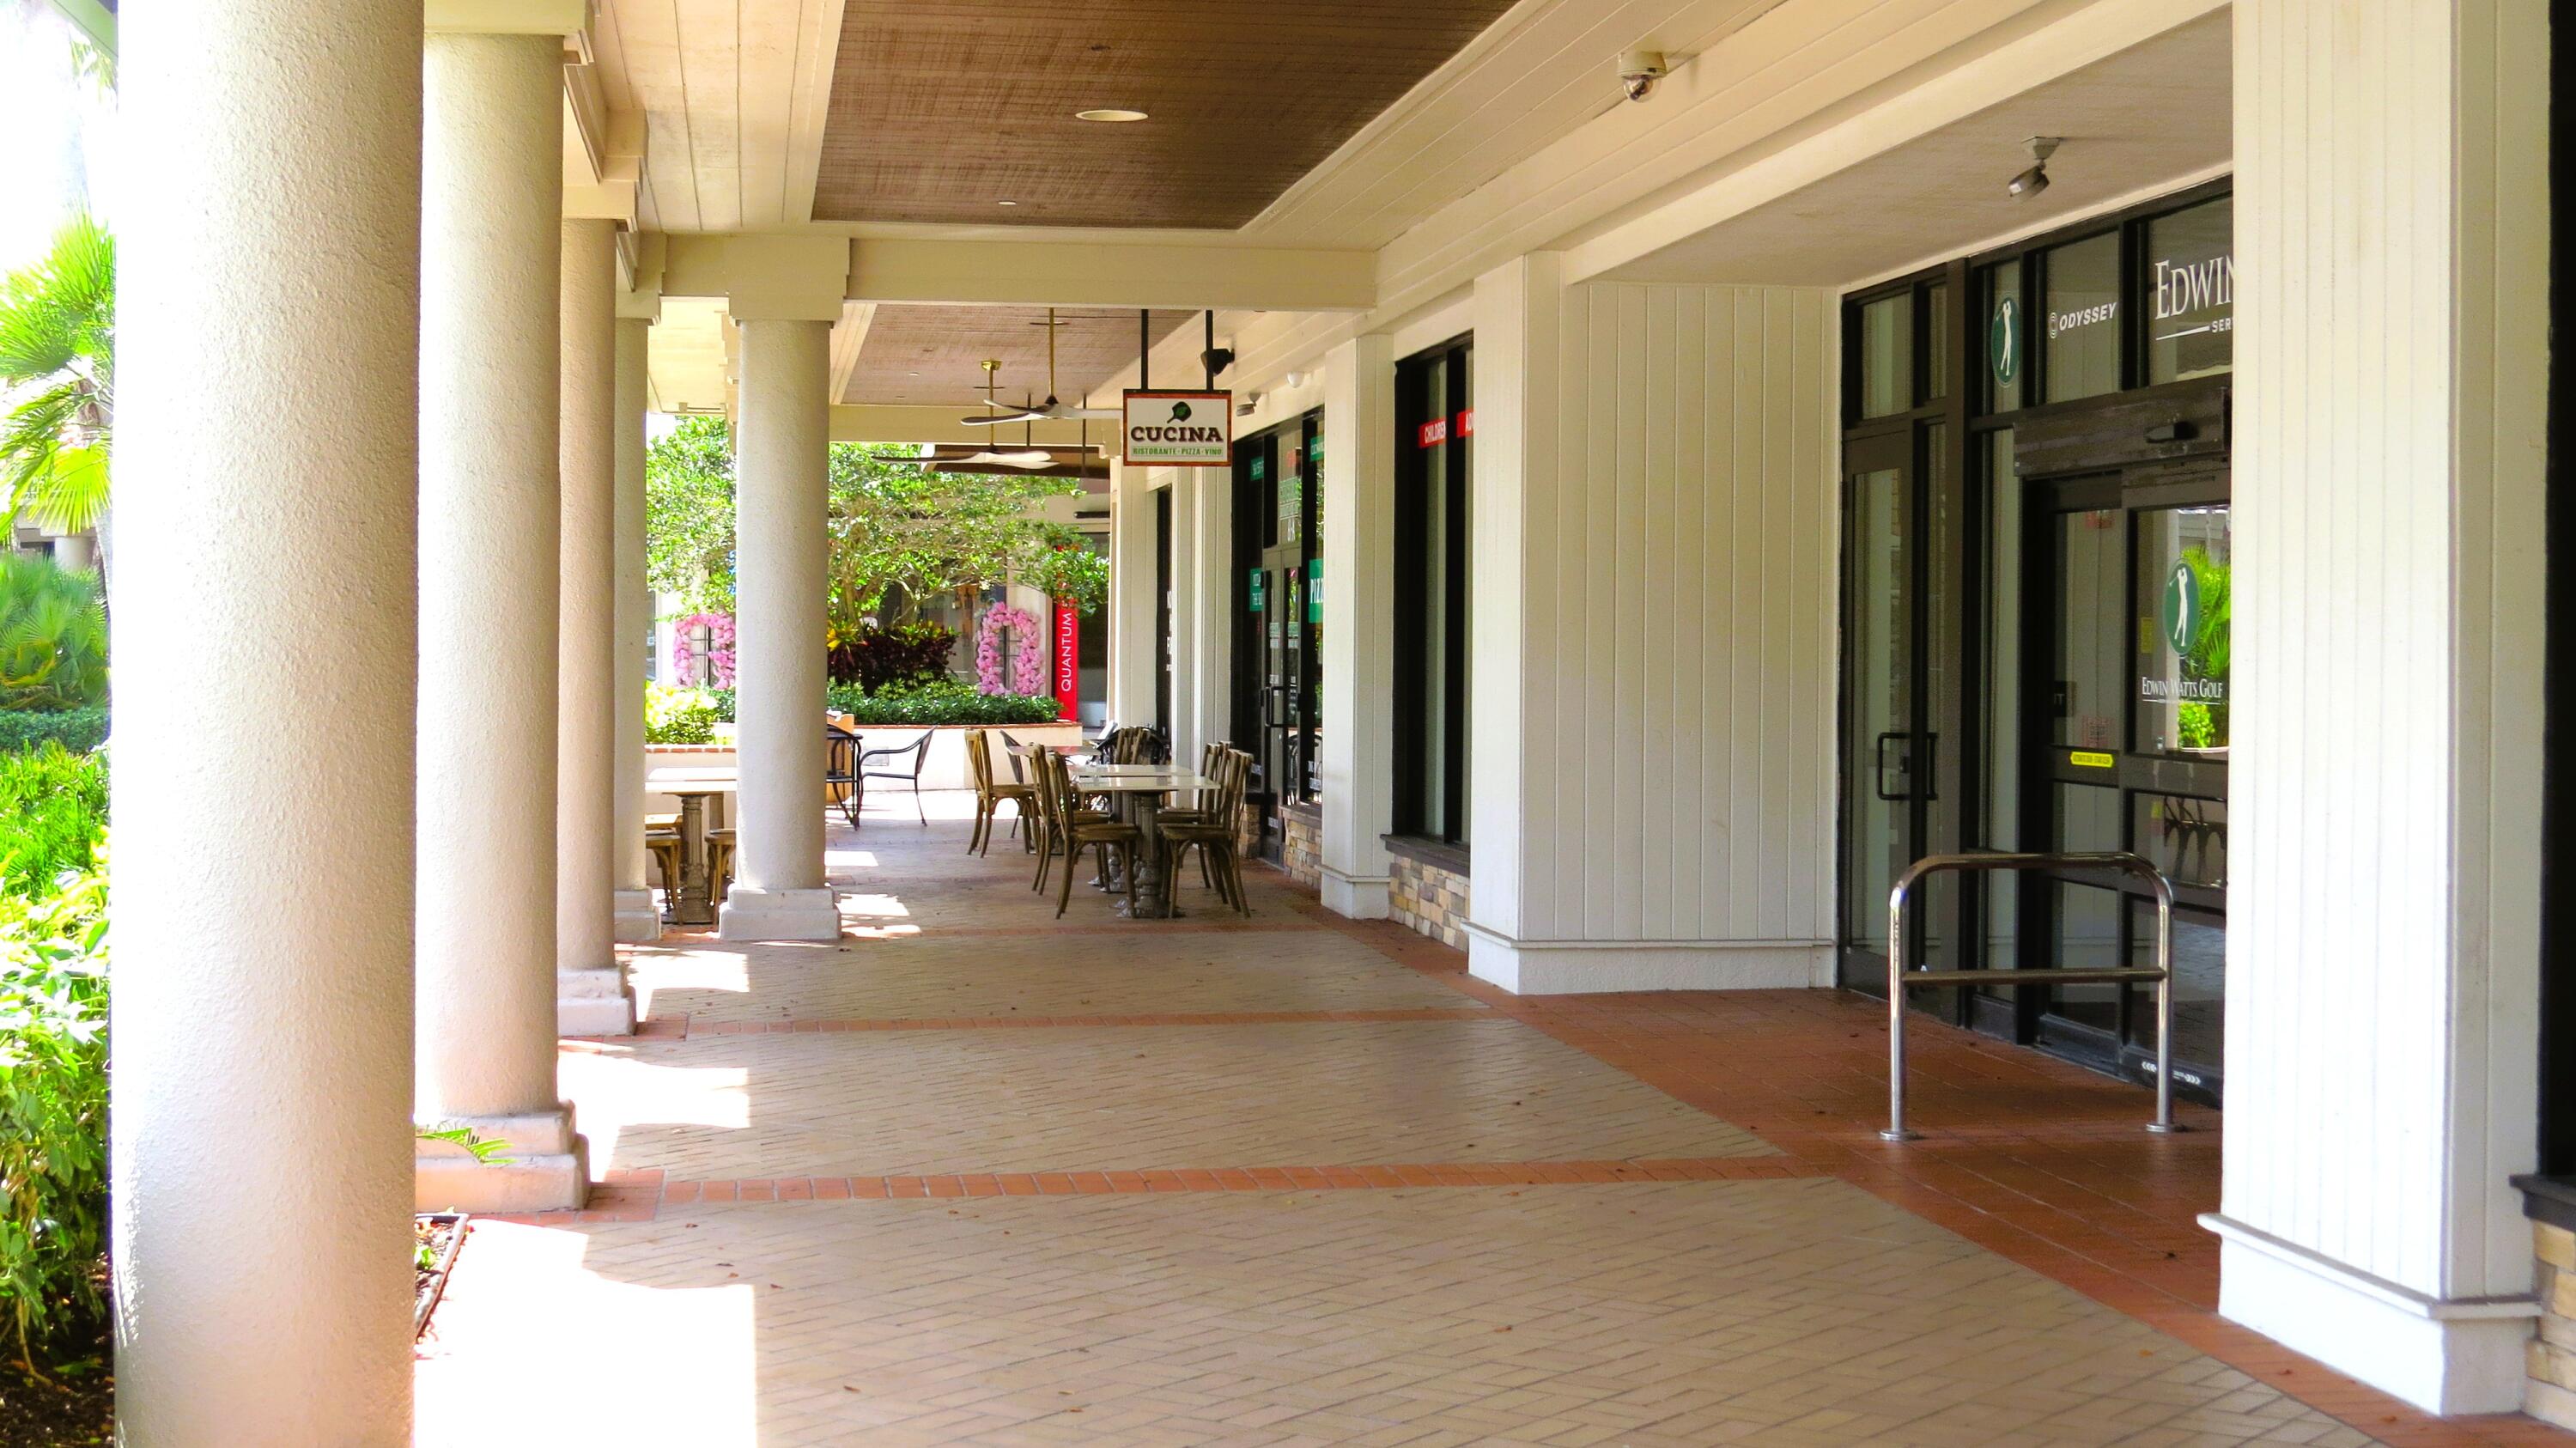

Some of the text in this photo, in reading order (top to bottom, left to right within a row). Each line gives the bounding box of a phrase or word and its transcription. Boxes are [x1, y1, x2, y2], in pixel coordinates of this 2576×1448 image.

[2059, 301, 2117, 331] ODYSSEY
[2212, 317, 2233, 333] SER
[1130, 425, 1224, 442] CUCINA
[1133, 446, 1222, 455] RISTORANTE PIZZA VINO
[1060, 612, 1072, 692] QUANTUM
[2142, 676, 2223, 698] EDWIN WATTS GOLF
